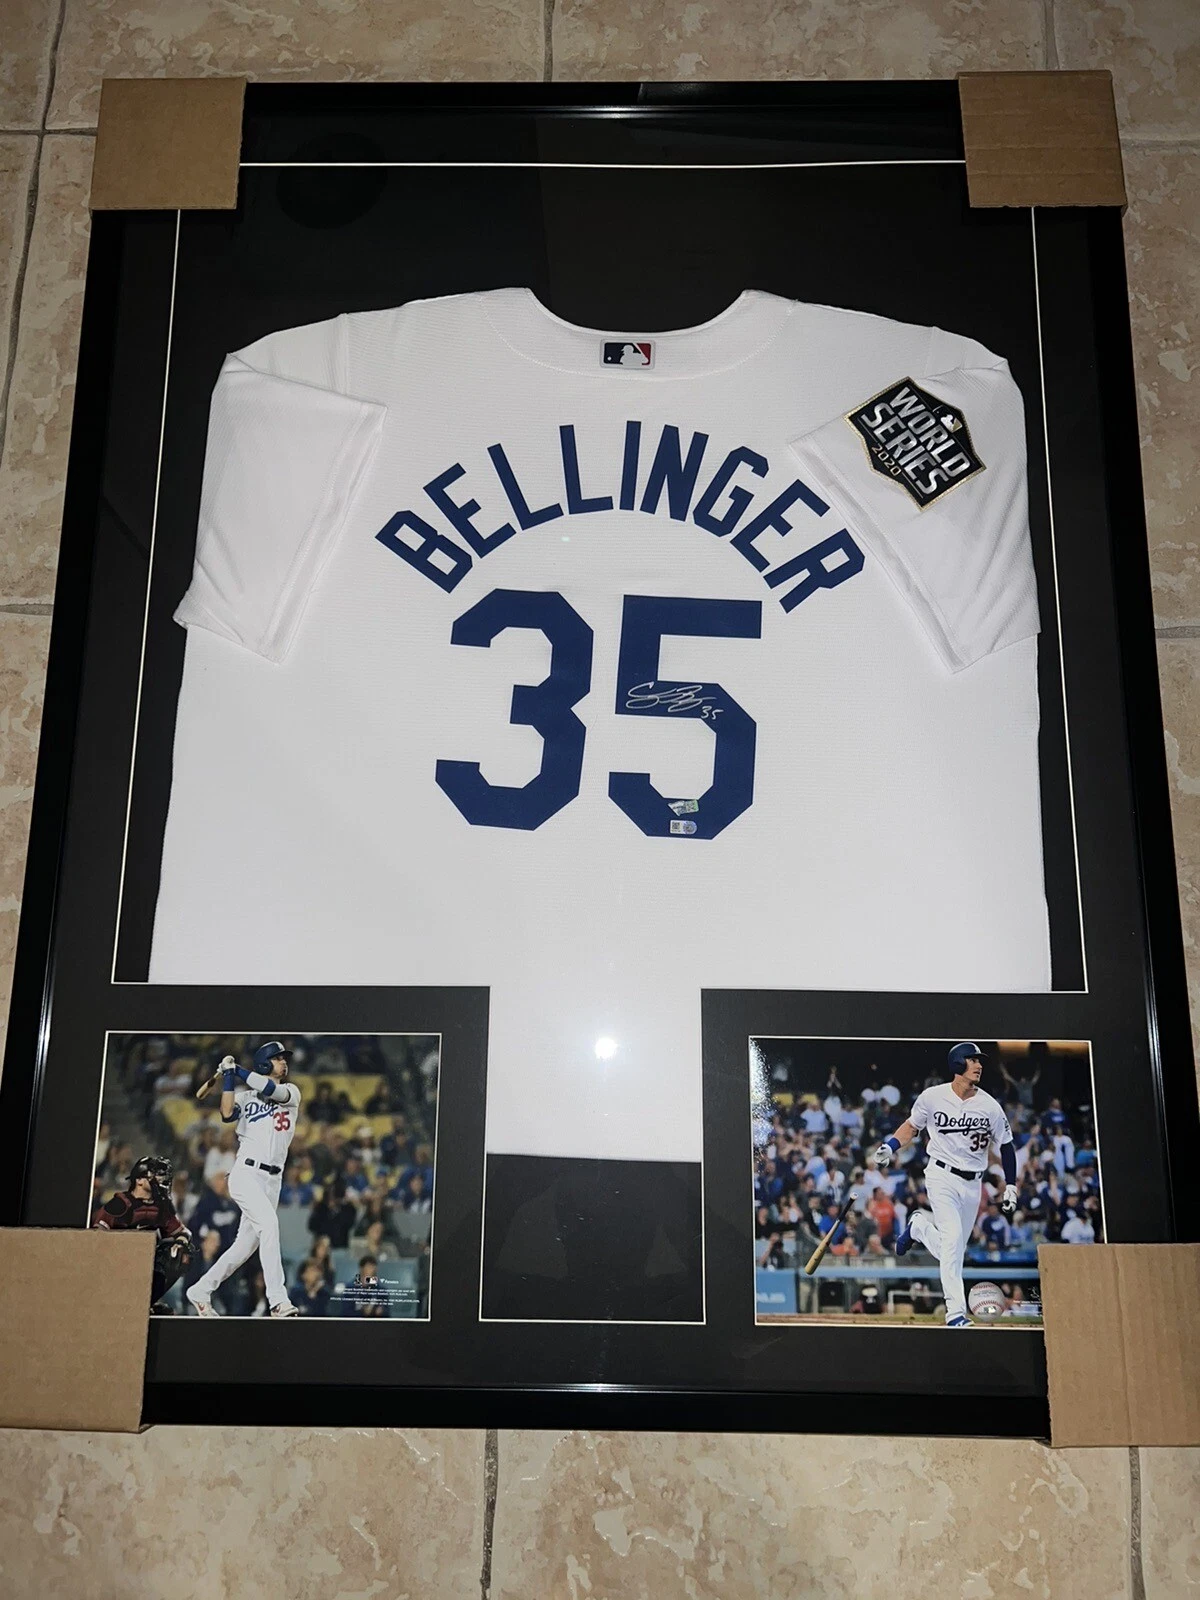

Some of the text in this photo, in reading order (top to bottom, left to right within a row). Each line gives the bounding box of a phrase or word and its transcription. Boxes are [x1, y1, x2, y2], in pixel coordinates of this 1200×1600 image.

[890, 387, 970, 477] WORLD
[861, 402, 949, 494] SERIES
[872, 445, 901, 476] 2020
[375, 420, 866, 614] BELLINGER
[435, 588, 763, 840] 35
[700, 705, 724, 720] 35
[273, 1111, 291, 1132] 35
[933, 1111, 991, 1136] Dodgers
[970, 1131, 992, 1152] 35
